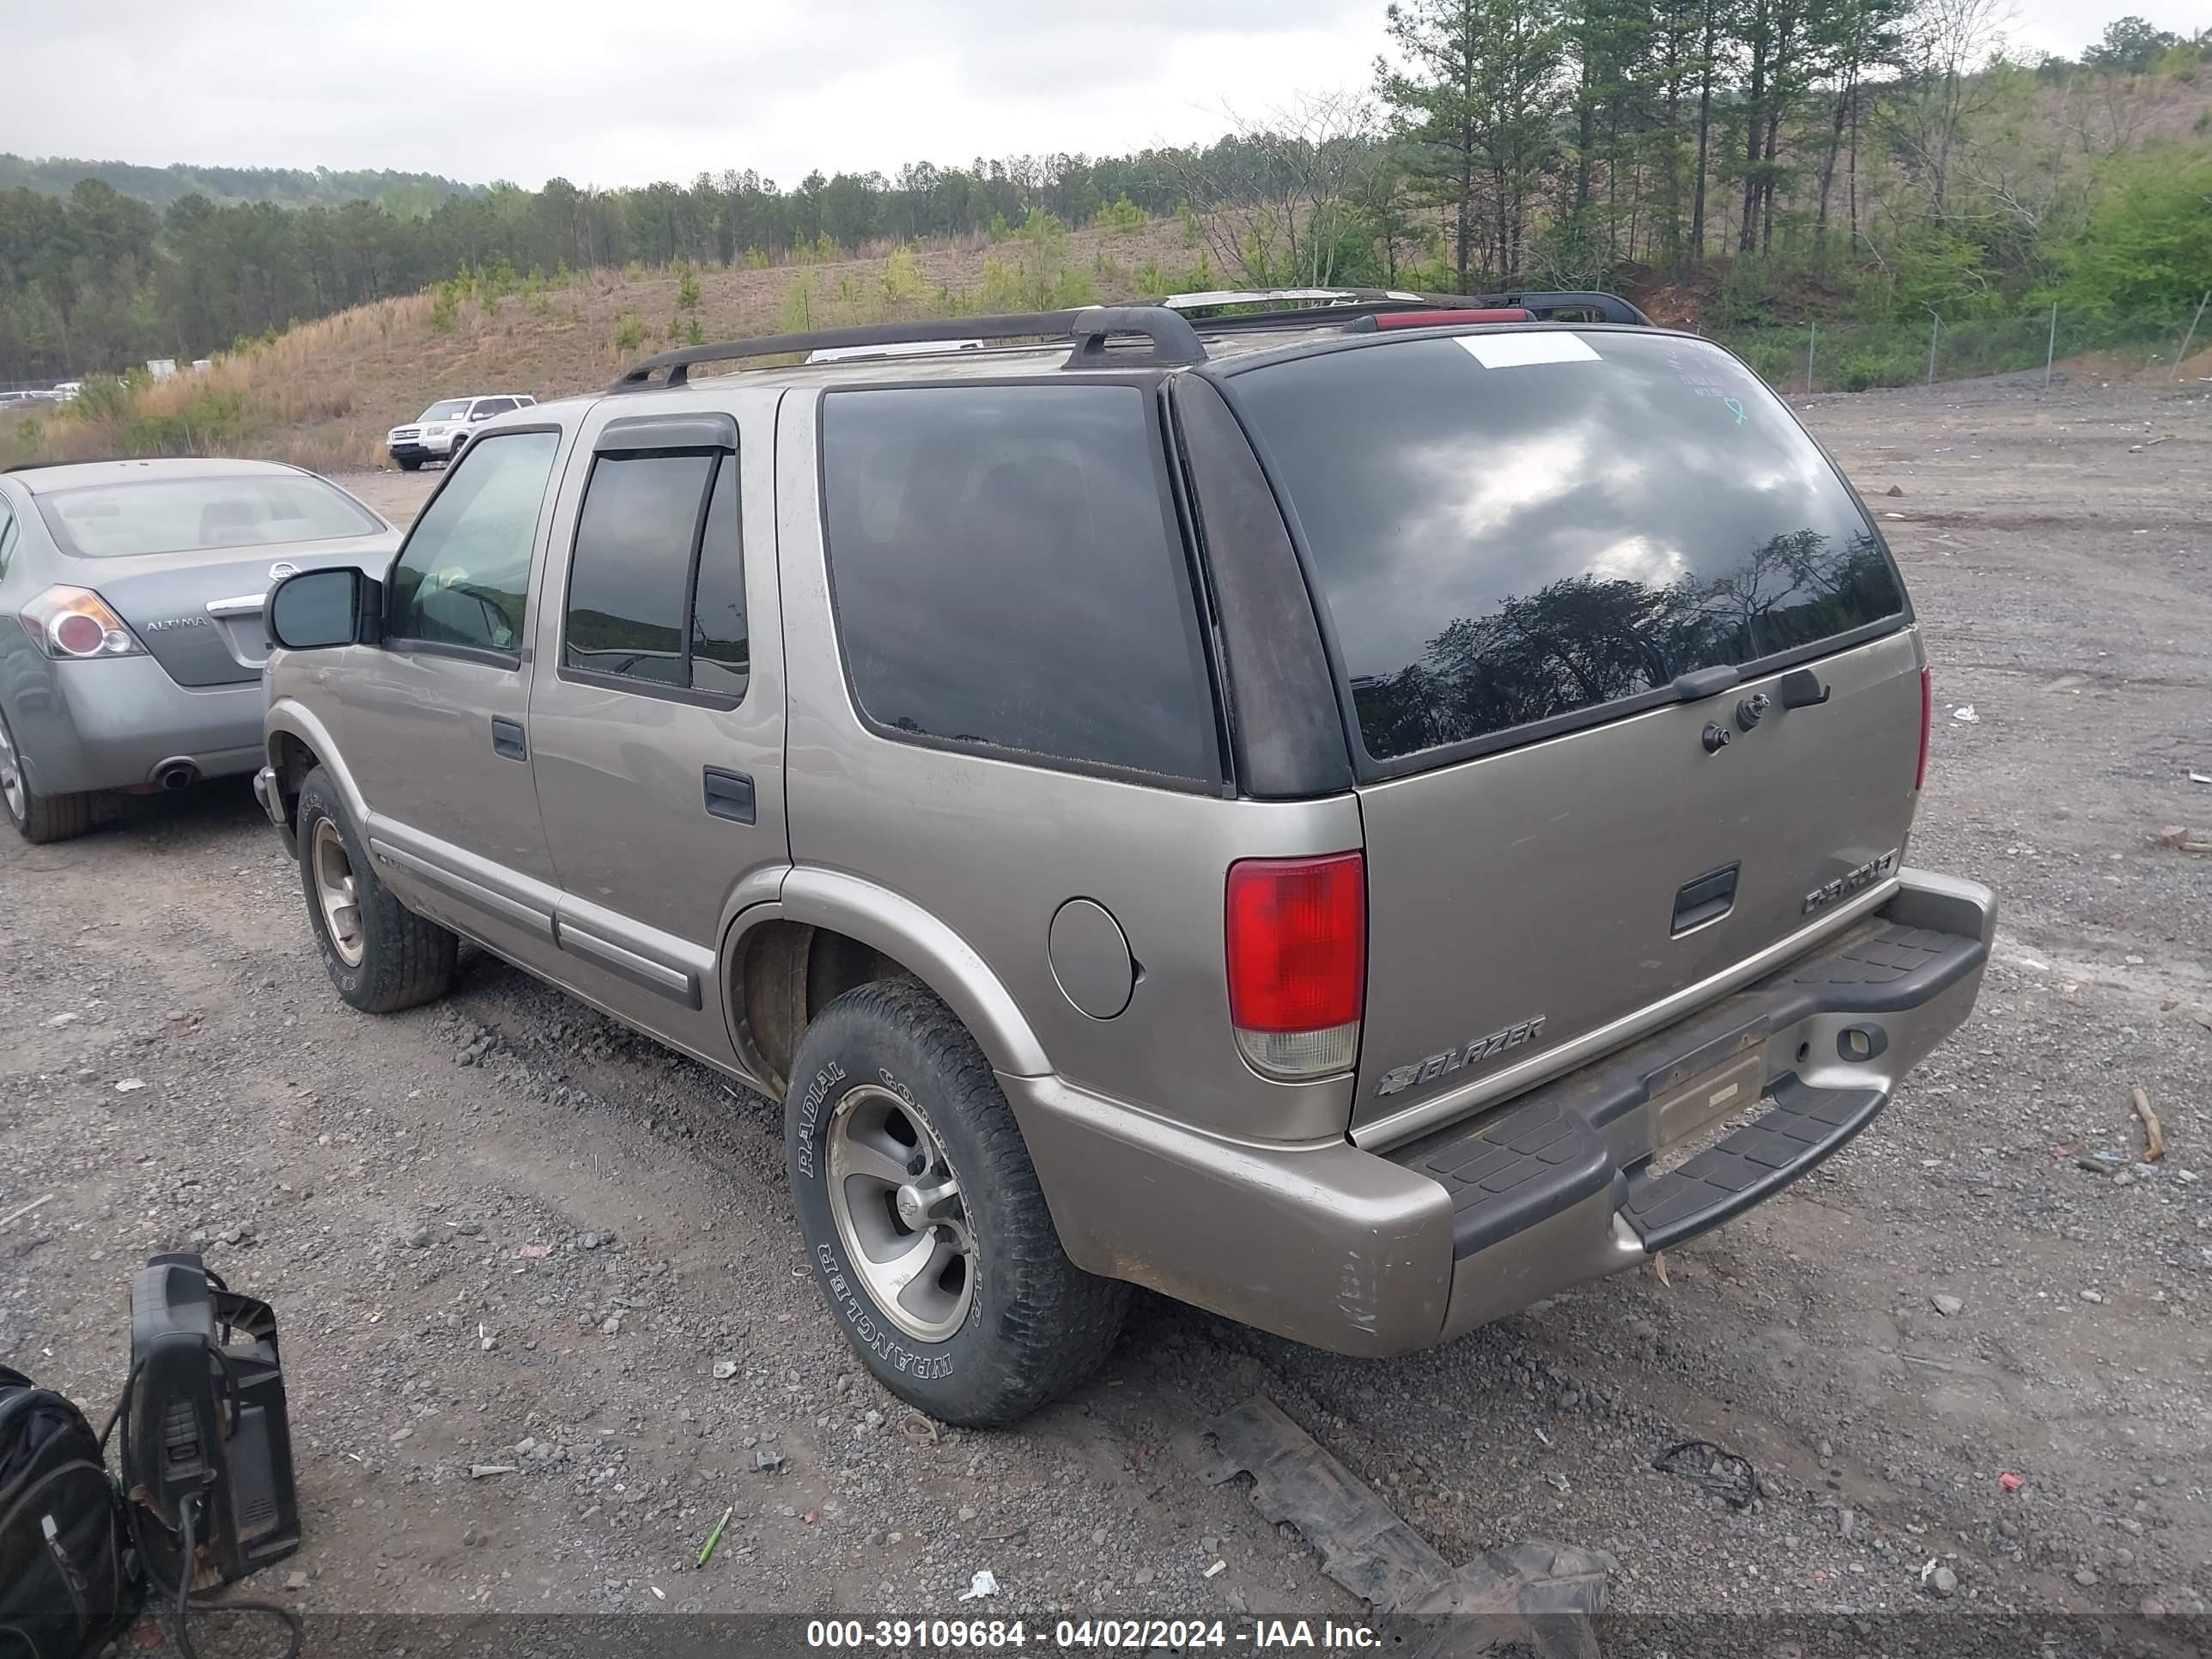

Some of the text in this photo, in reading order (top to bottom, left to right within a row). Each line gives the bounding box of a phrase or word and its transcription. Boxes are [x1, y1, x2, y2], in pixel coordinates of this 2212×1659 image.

[146, 617, 207, 632] ALTIMA
[1802, 848, 1898, 914] CHEVROLET
[1418, 1014, 1547, 1085] BLAZER
[798, 1061, 847, 1179] RADIAL
[817, 1244, 953, 1380] WRANGLER
